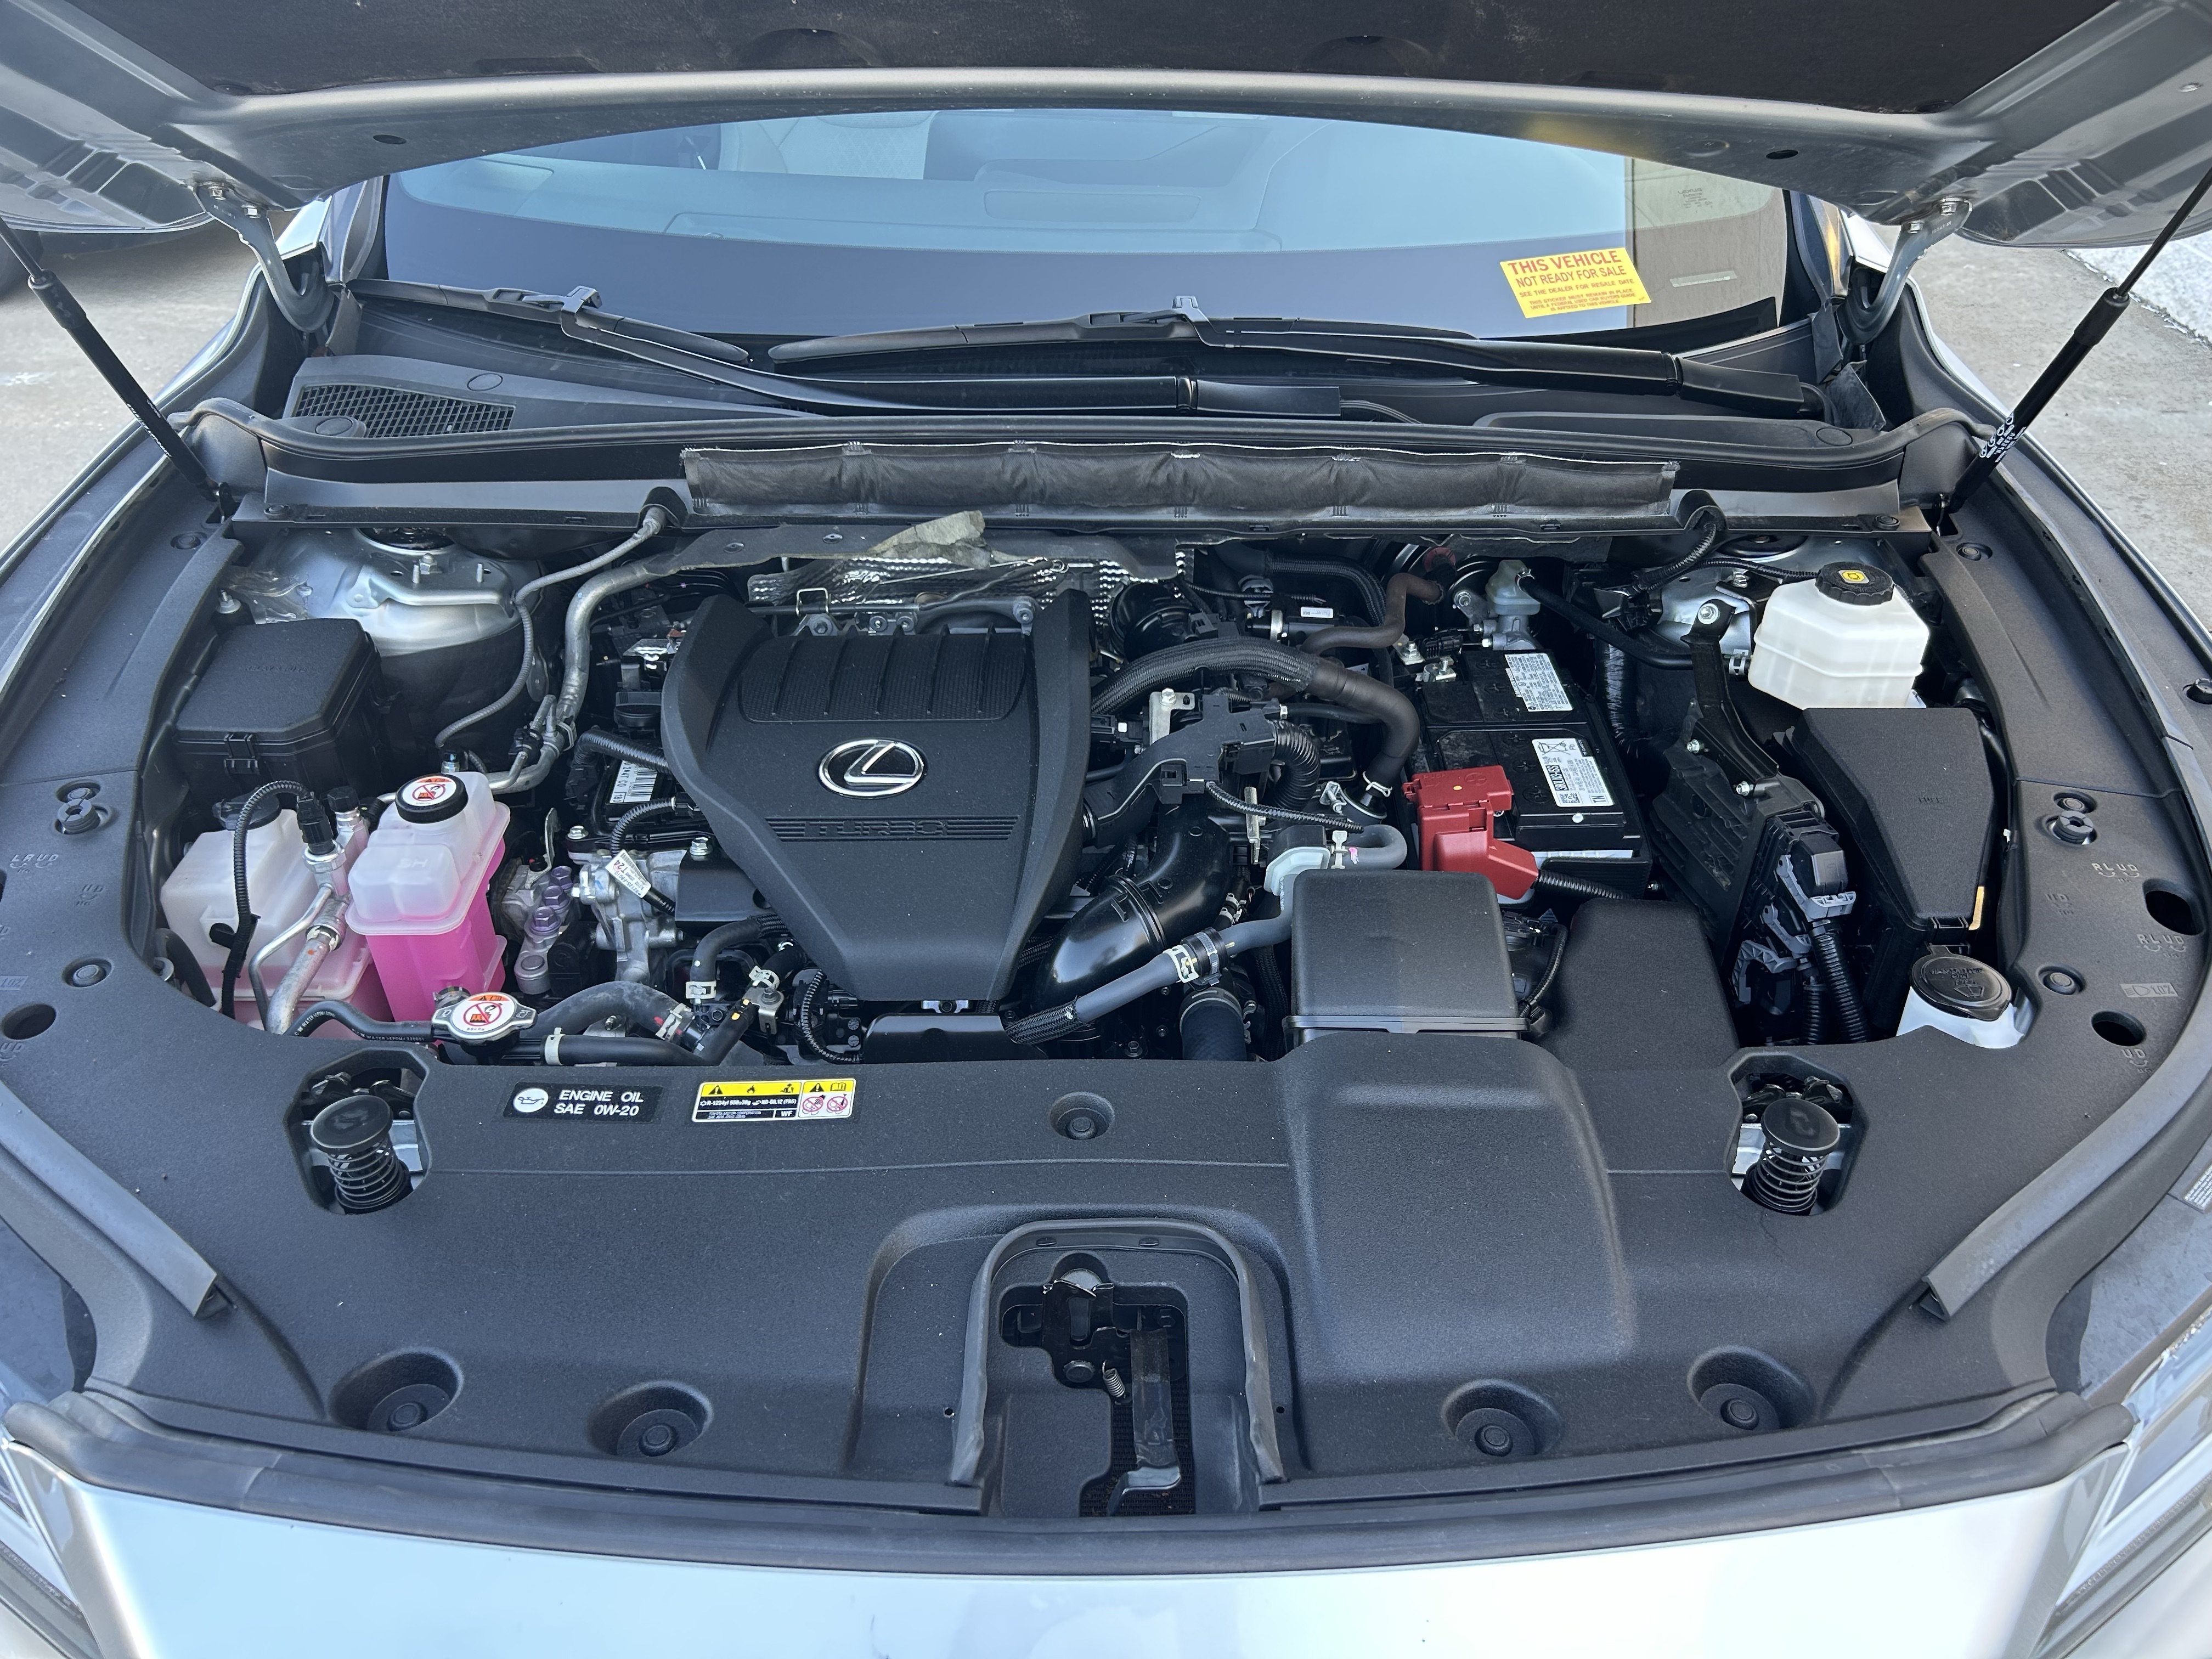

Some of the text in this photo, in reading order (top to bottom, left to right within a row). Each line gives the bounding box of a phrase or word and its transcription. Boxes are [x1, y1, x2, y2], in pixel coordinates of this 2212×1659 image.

[1508, 250, 1622, 275] THIS VEHICLE
[1516, 265, 1627, 288] NOT READY FOR SALE
[1549, 285, 1573, 294] DEALER
[1592, 795, 1607, 804] TN
[809, 820, 944, 836] TURBO
[301, 1014, 315, 1028] WATER
[558, 1090, 644, 1103] ENGINE OIL
[554, 1103, 640, 1116] SAE 0W-20
